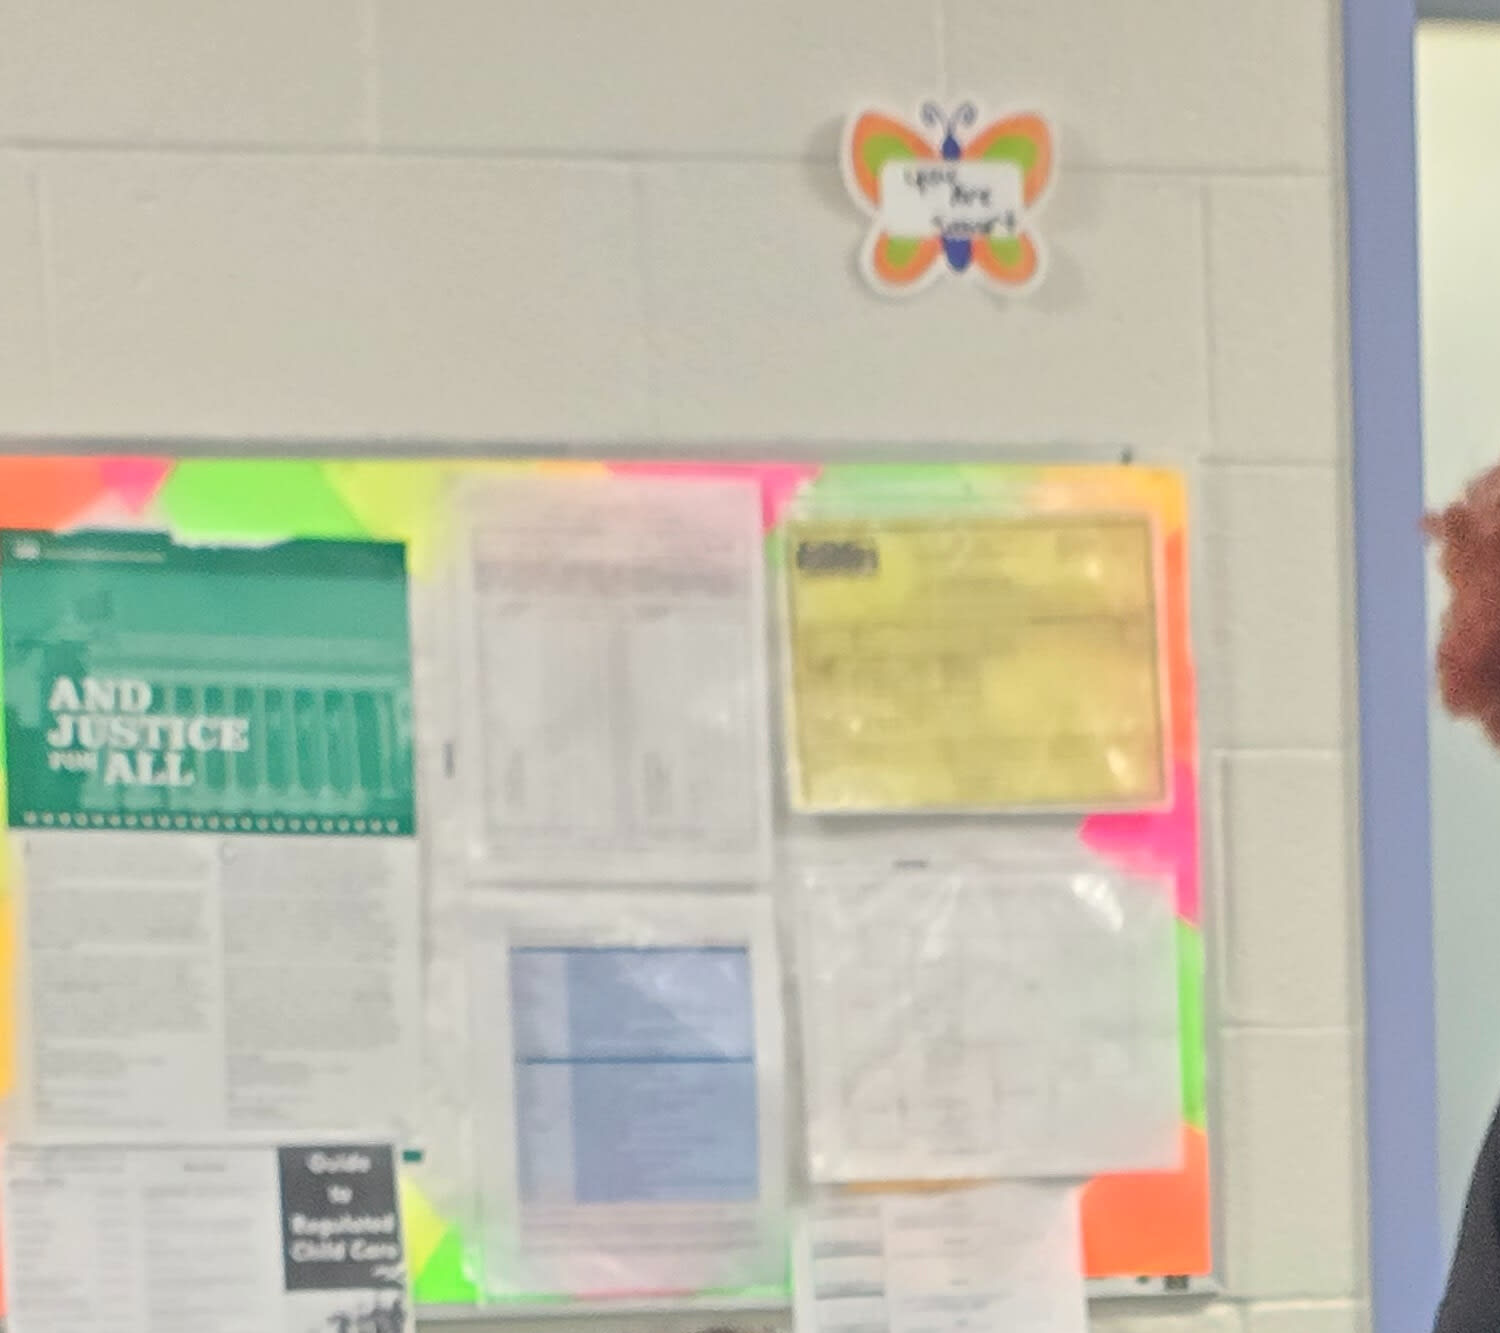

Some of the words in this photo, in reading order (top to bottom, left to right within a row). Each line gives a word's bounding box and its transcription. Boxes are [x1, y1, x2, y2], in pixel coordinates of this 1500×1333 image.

[48, 676, 152, 712] AND
[46, 713, 250, 752] JUSTICE
[104, 751, 195, 787] ALL
[305, 1151, 371, 1175] Guide
[327, 1185, 353, 1205] to
